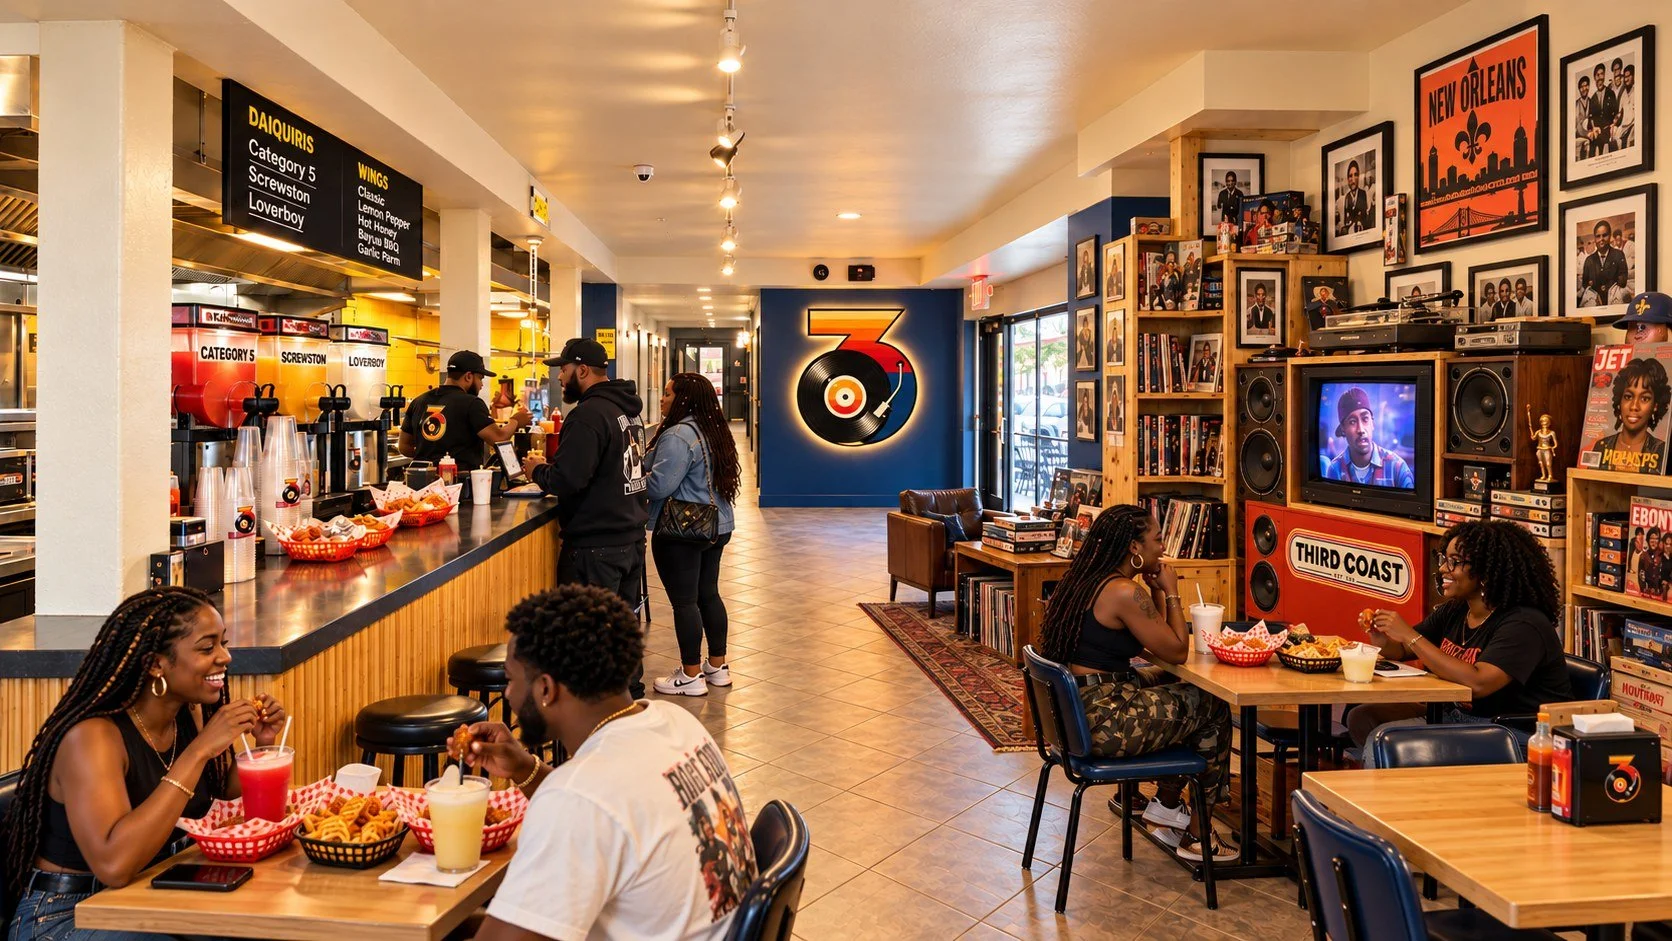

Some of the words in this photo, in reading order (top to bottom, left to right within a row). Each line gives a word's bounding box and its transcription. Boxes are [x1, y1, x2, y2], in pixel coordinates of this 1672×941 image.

[1428, 81, 1457, 128] NEW
[1460, 55, 1527, 112] ORLEANS
[248, 105, 315, 154] DAIQUIRIS
[248, 138, 306, 181] Category
[308, 166, 316, 182] 5
[357, 161, 389, 190] WINGS
[248, 165, 311, 205] Screwston
[248, 191, 305, 230] Loverboy
[358, 199, 384, 220] Lemon
[385, 210, 411, 231] Pepper
[357, 213, 372, 230] Hot
[373, 220, 398, 241] Honey
[357, 242, 381, 260] Garlic
[381, 250, 401, 266] Parm
[200, 345, 249, 362] CATEGORY
[249, 349, 255, 362] 5
[281, 351, 327, 365] SCREWSTON
[1594, 348, 1632, 371] JET
[1295, 541, 1341, 570] THIRD
[1343, 552, 1404, 585] COAST
